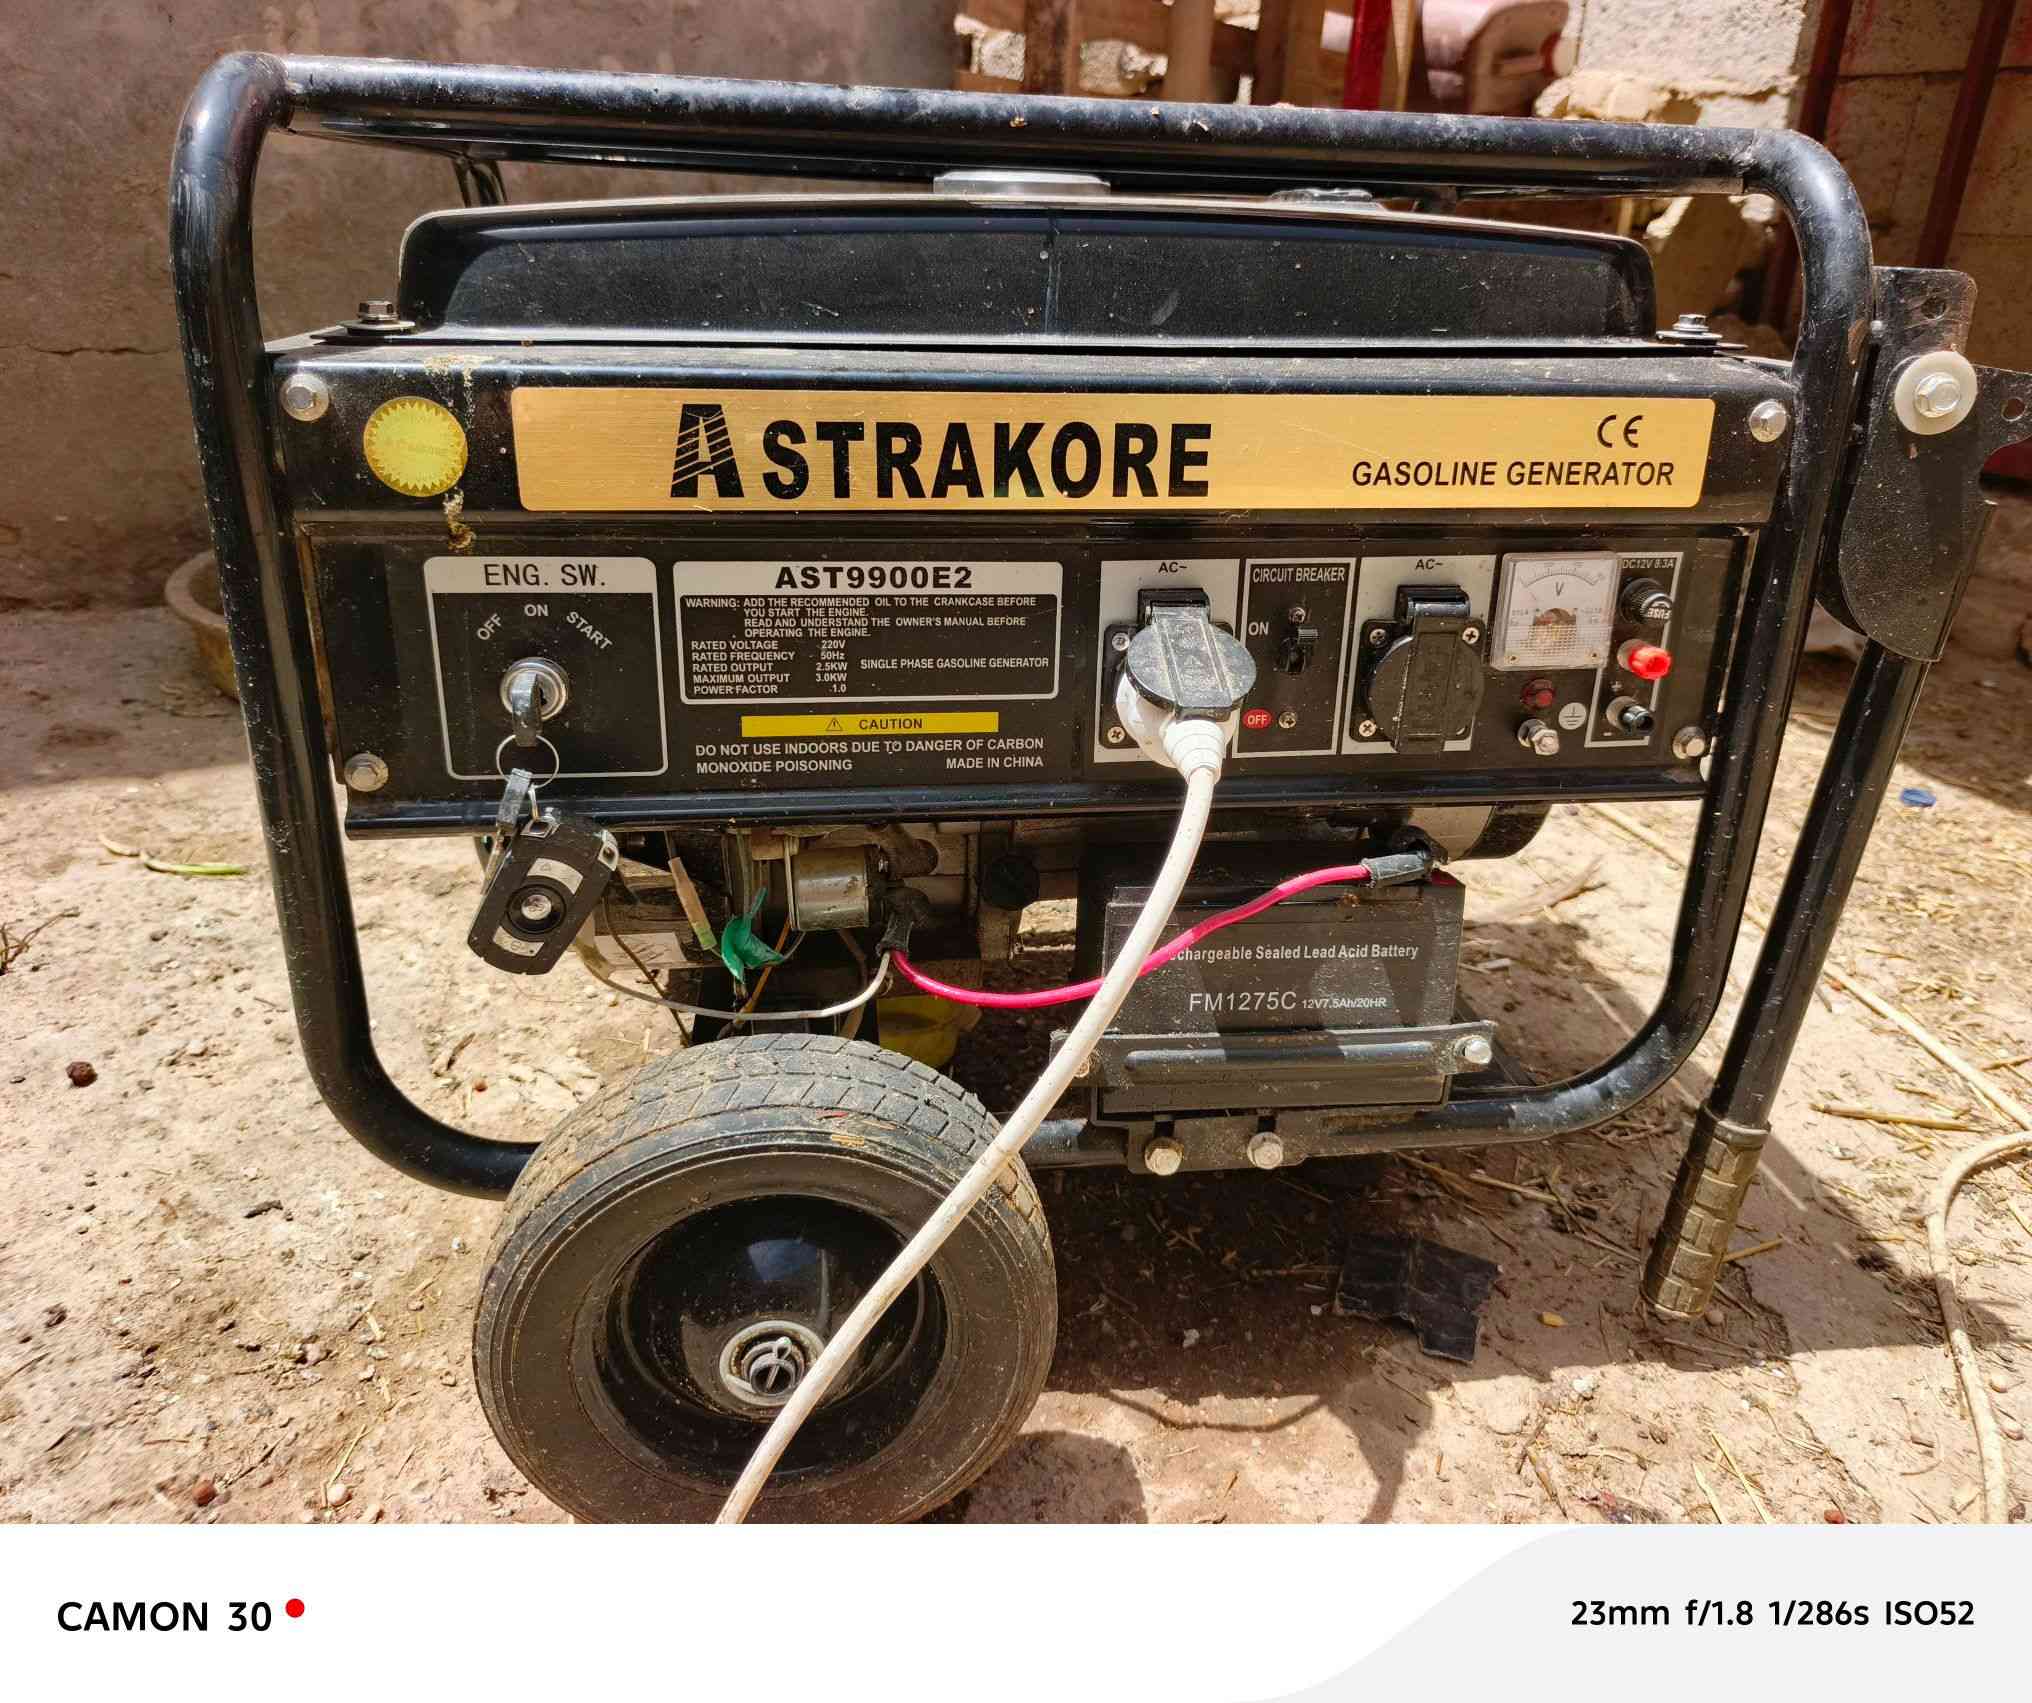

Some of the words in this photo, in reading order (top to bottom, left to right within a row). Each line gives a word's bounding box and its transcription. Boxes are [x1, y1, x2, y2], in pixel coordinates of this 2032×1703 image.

[1597, 415, 1643, 448] CE
[670, 403, 1212, 499] ASTRAKORE
[1352, 461, 1497, 486] GASOLINE
[1506, 461, 1674, 486] GENERATOR
[1622, 559, 1654, 569] DC12V
[484, 564, 549, 586] ENG.
[561, 564, 606, 586] SW.
[774, 566, 973, 589] AST9900E2
[1253, 568, 1294, 583] CIRCUIT
[1296, 567, 1345, 582] BREAKER
[1555, 581, 1564, 597] V
[685, 598, 740, 608] WARNING:
[743, 597, 765, 607] ADD
[768, 597, 788, 607] THE
[790, 597, 870, 607] RECOMMENDED
[875, 597, 891, 607] OIL
[895, 597, 907, 607] TO
[911, 597, 929, 607] THE
[934, 597, 994, 607] CRANKCASE
[997, 597, 1037, 607] BEFORE
[524, 604, 549, 617] ON
[744, 608, 765, 617] YOU
[768, 608, 800, 617] START
[807, 608, 825, 617] THE
[828, 608, 869, 617] ENGINE.
[1647, 607, 1673, 620] FUSE
[476, 612, 503, 641] OFF
[744, 618, 770, 627] READ
[774, 618, 796, 627] AND
[801, 618, 869, 627] UNDERSTAND
[871, 617, 891, 627] THE
[895, 617, 941, 627] OWNER'S
[944, 617, 984, 627] MANUAL
[987, 617, 1026, 627] BEFORE
[566, 611, 613, 650] START
[744, 628, 803, 638] OPERATING
[808, 628, 826, 638] THE
[830, 628, 871, 638] ENGINE.
[1248, 622, 1269, 636] ON
[691, 640, 726, 650] RATED
[730, 640, 779, 650] VOLTAGE
[822, 640, 846, 649] 220V
[692, 652, 727, 662] RATED
[730, 652, 795, 662] FREQUENCY
[820, 651, 846, 660] 50Hz
[692, 663, 727, 673] RATED
[730, 663, 774, 673] OUTPUT
[816, 662, 848, 672] 2.5KW
[861, 657, 898, 669] SINGLE
[900, 657, 934, 669] PHASE
[936, 657, 987, 669] GASOLINE
[989, 657, 1049, 669] GENERATOR
[693, 674, 744, 684] MAXIMUM
[747, 674, 791, 684] OUTPUT
[816, 673, 848, 682] 3.0KW
[694, 685, 735, 695] POWER
[736, 685, 779, 695] FACTOR
[859, 719, 923, 730] CAUTION
[1247, 714, 1268, 725] OFF
[695, 744, 717, 756] DO
[720, 743, 749, 756] NOT
[753, 743, 782, 755] USE
[785, 741, 848, 755] INDOORS
[852, 740, 880, 753] DUE
[884, 740, 902, 753] TO
[905, 739, 962, 752] DANGER
[966, 738, 984, 751] OF
[986, 737, 1045, 750] CARBON
[696, 760, 772, 774] MONOXIDE
[776, 759, 854, 773] POISONING
[946, 757, 984, 769] MADE
[988, 756, 1000, 769] IN
[1003, 755, 1044, 768] CHINA
[1169, 945, 1253, 963] chargeable
[1256, 945, 1301, 959] Sealed
[1304, 945, 1336, 959] Lead
[1337, 944, 1369, 958] Acid
[1371, 943, 1419, 960] Battery
[1189, 991, 1297, 1012] FM1275C
